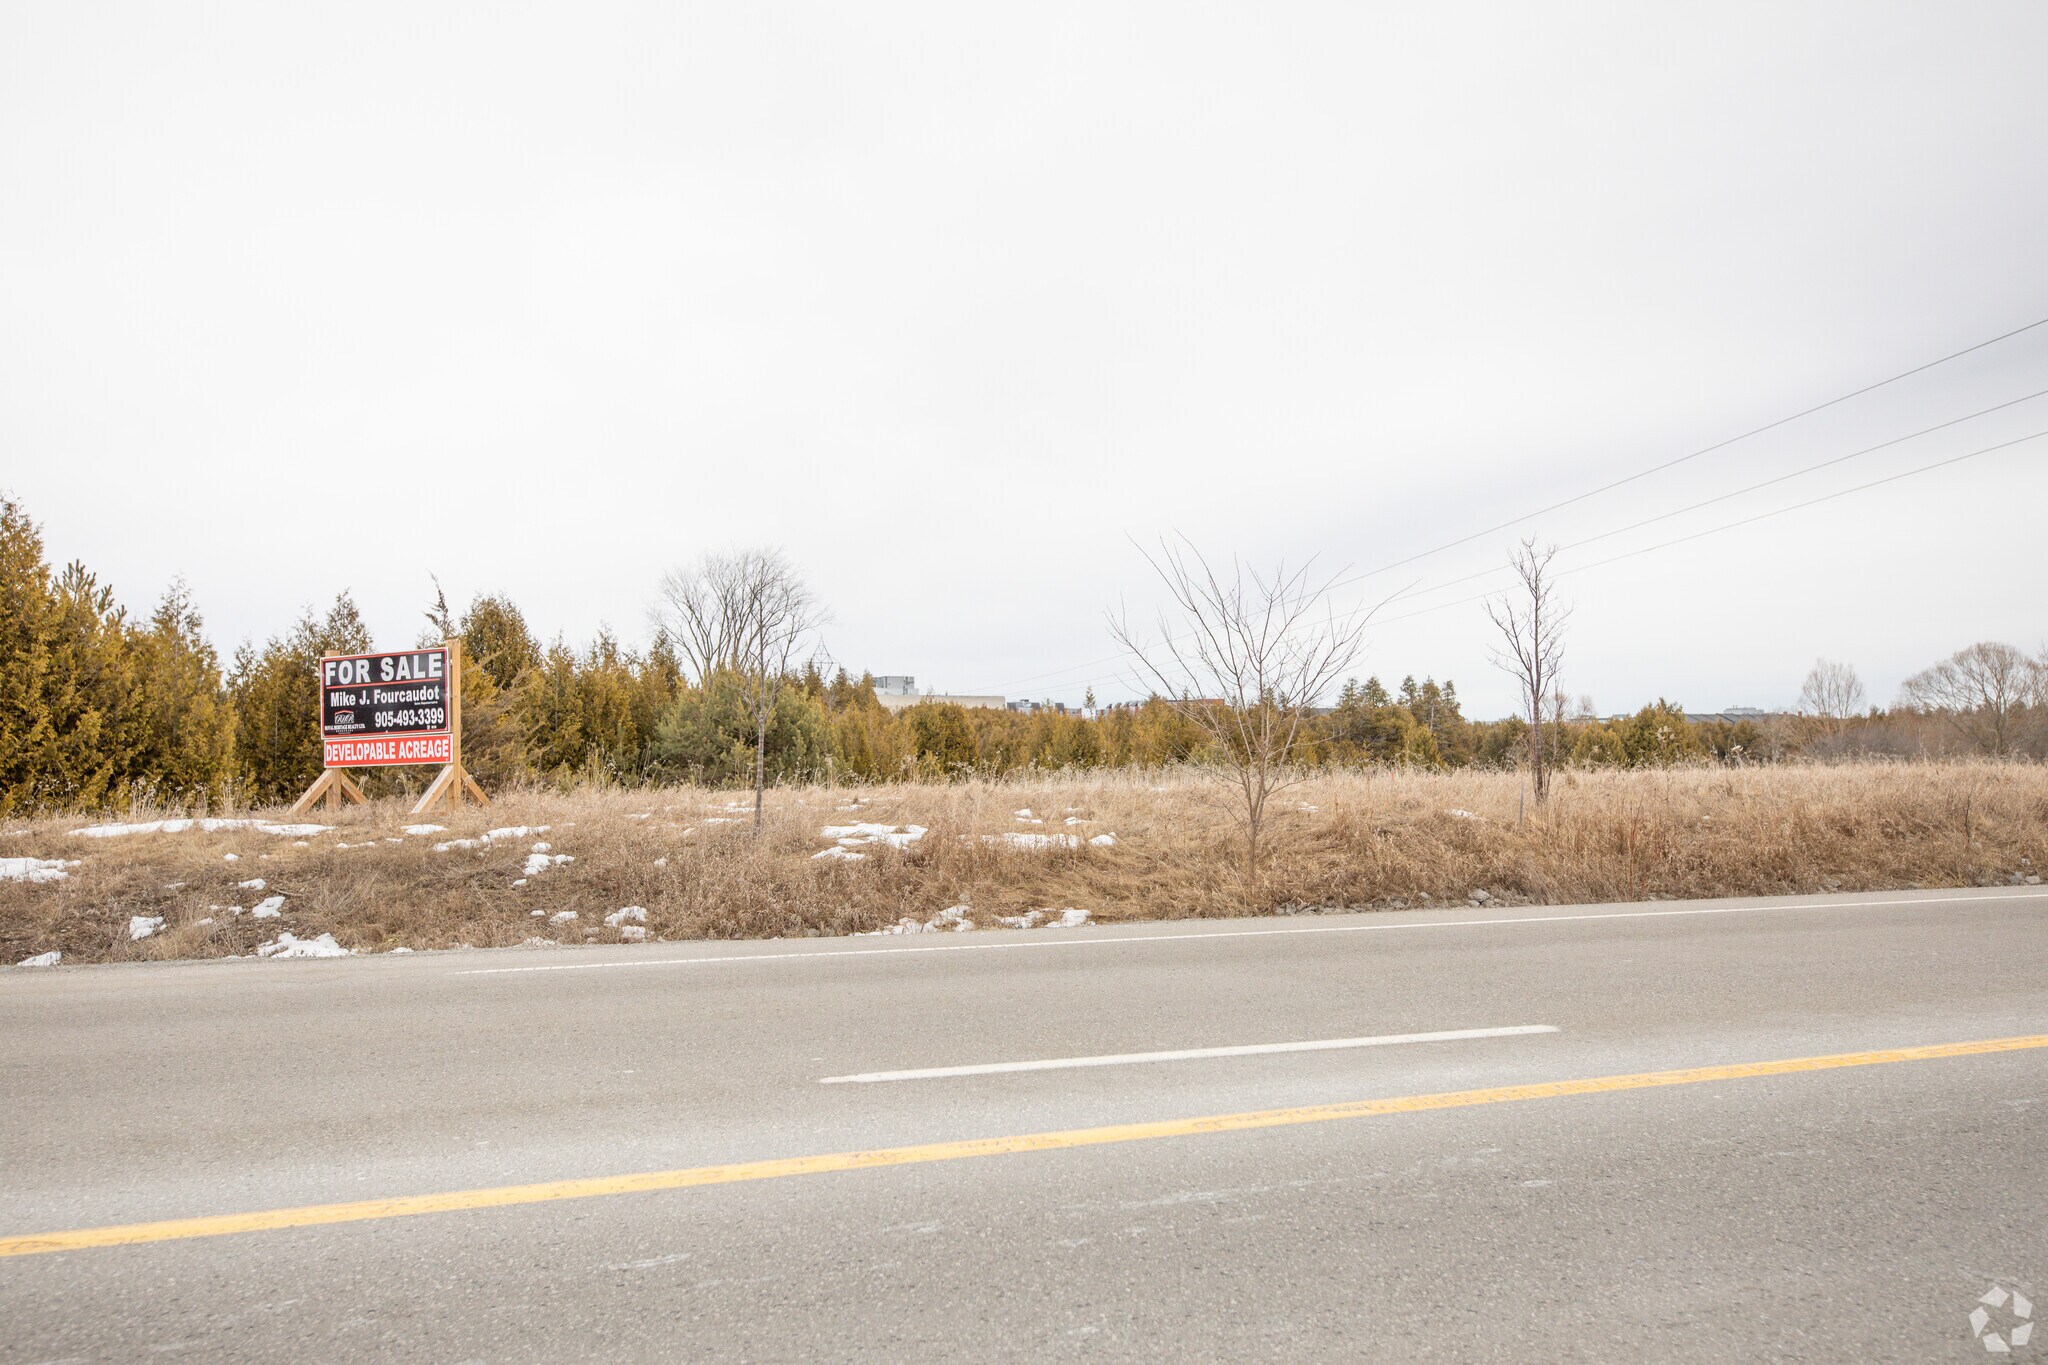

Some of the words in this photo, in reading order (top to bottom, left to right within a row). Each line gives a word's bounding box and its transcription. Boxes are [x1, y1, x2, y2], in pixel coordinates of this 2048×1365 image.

[325, 660, 371, 686] FOR
[380, 653, 442, 681] SALE
[330, 691, 356, 707] Mike
[359, 690, 370, 706] J.
[373, 685, 440, 703] Fourcaudot
[375, 708, 444, 727] 905-493-3399
[326, 742, 396, 761] DEVELOPABLE
[398, 739, 449, 759] ACREAGE
